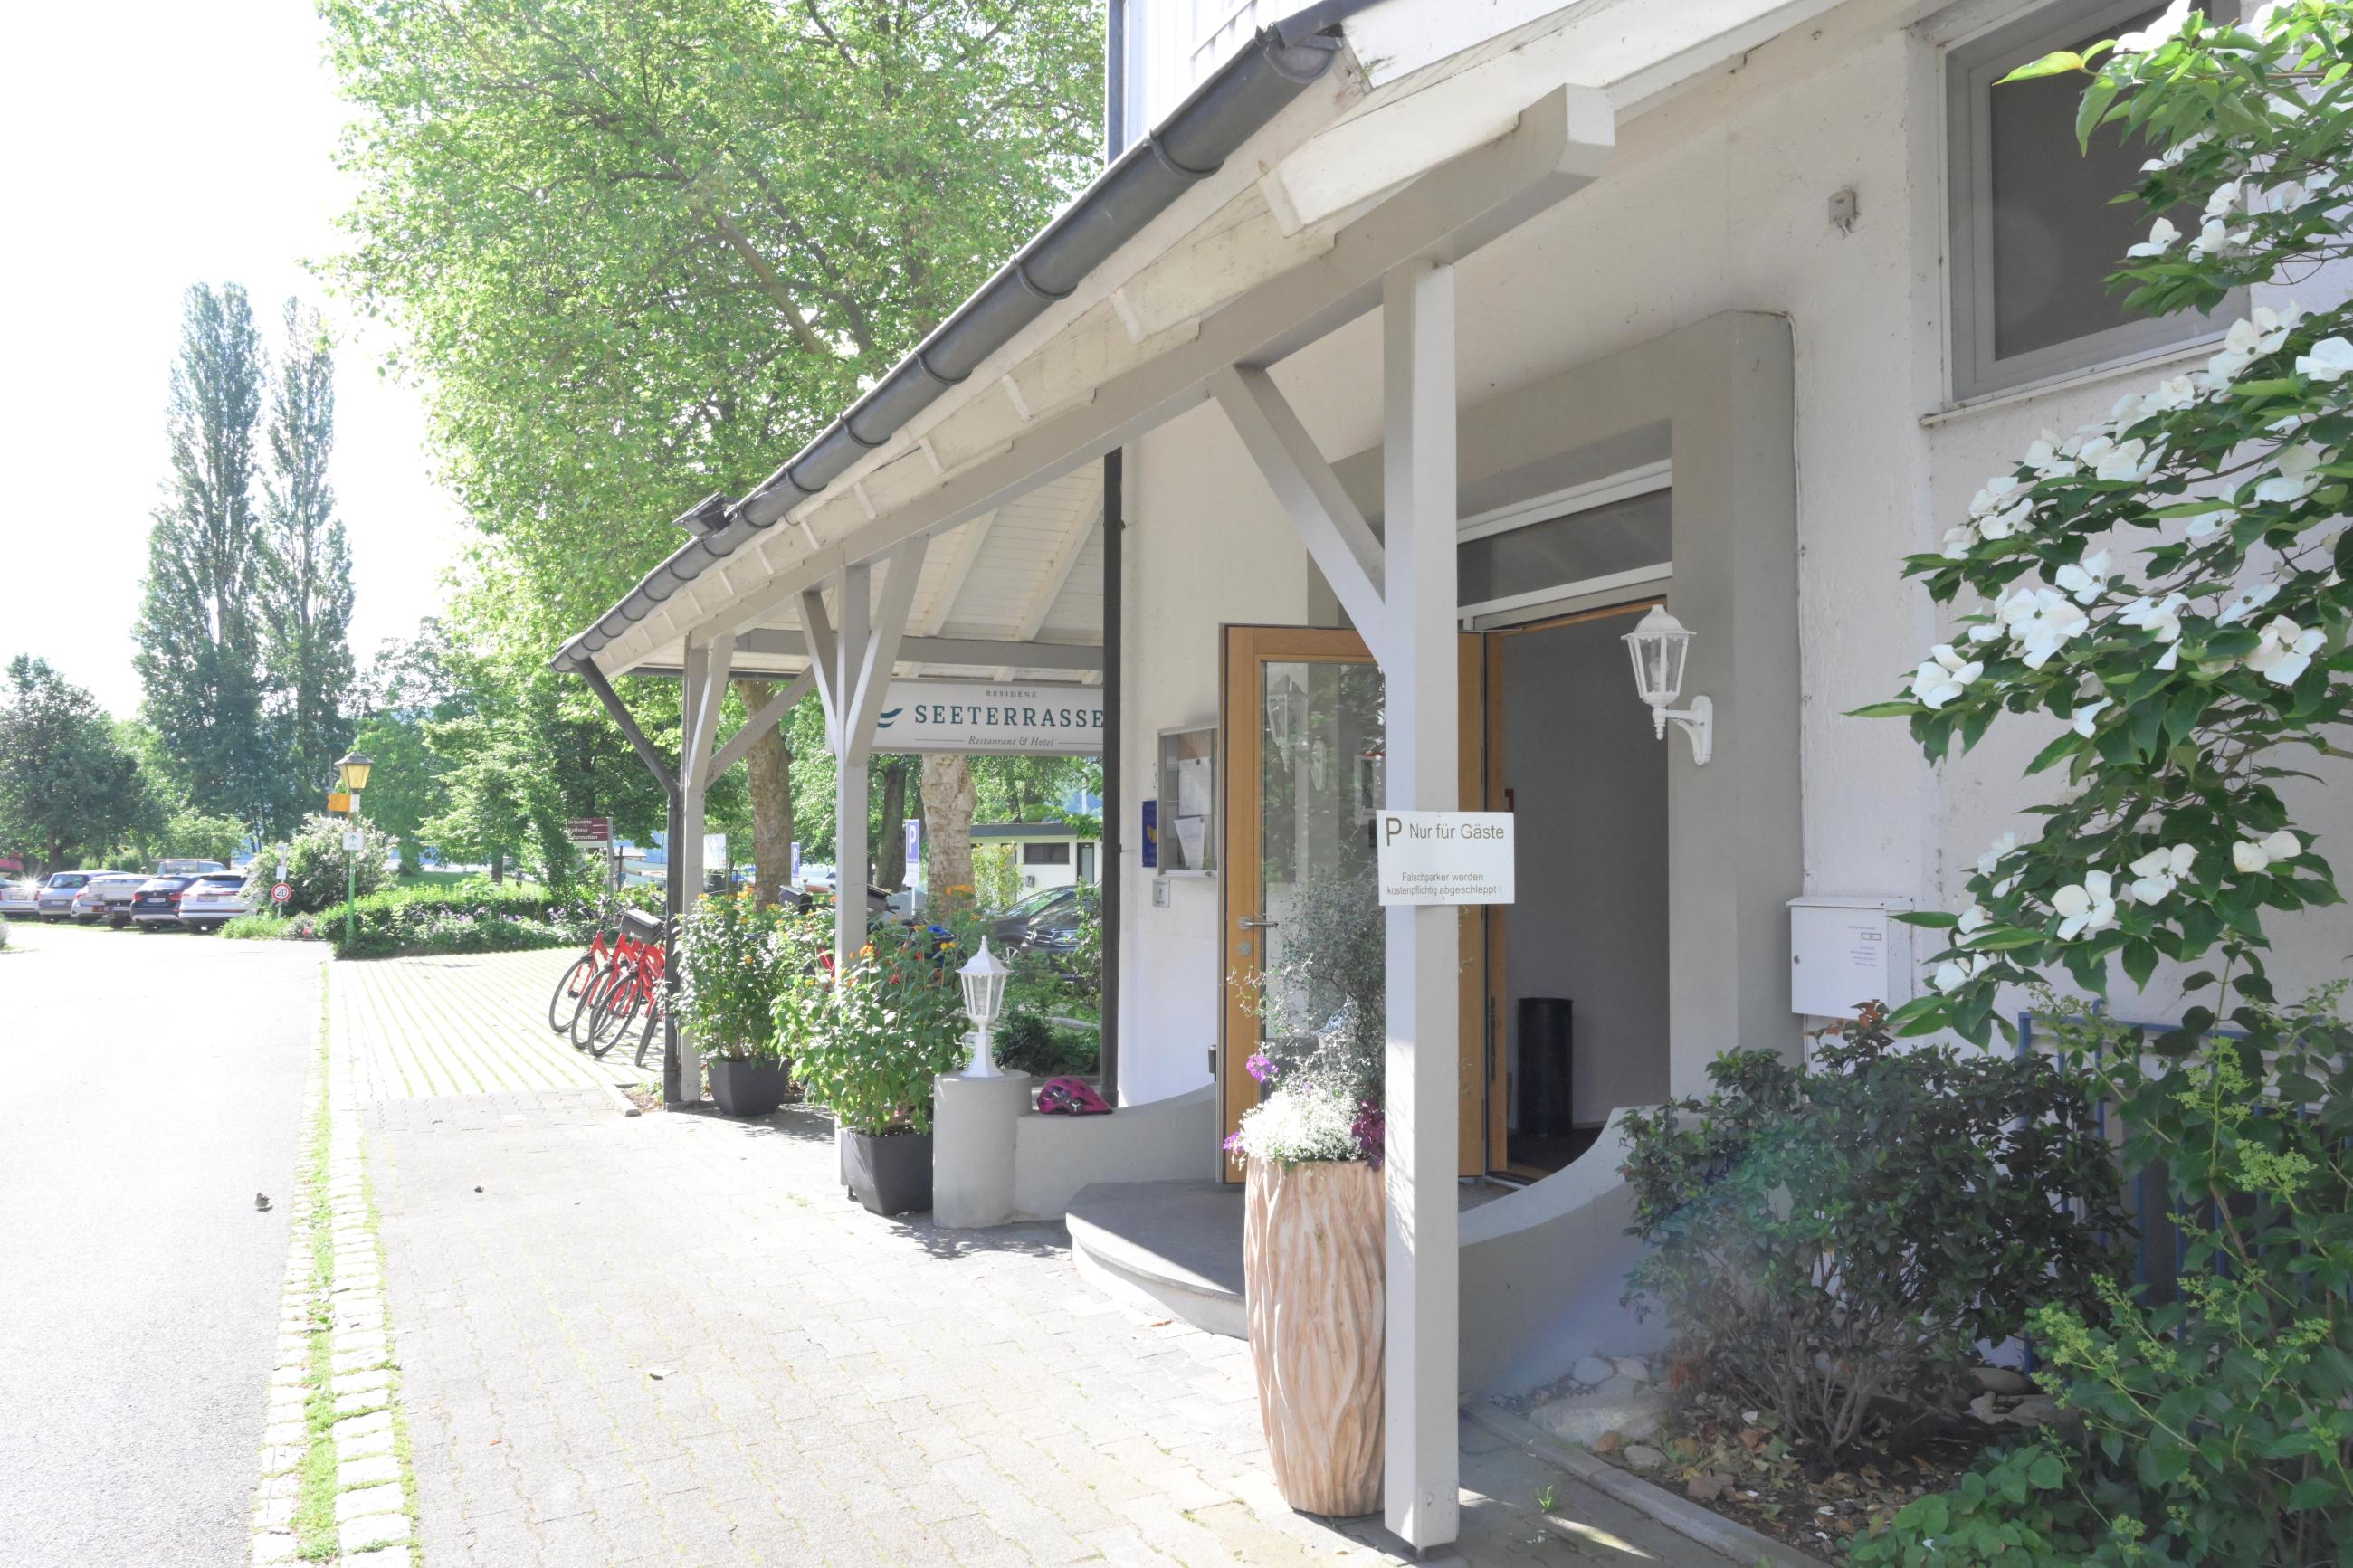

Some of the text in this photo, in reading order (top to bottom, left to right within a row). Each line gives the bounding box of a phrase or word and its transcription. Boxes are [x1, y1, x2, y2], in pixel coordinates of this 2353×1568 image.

[915, 704, 1103, 728] SEETERRASSE
[967, 735, 1054, 746] Restaurant & Hotel
[908, 825, 917, 854] P
[1386, 817, 1504, 847] P Nur für Gäste
[793, 847, 798, 870] P
[1402, 872, 1483, 883] Falschparker werden
[276, 888, 288, 898] 20
[1386, 885, 1437, 897] kostenpflichtig
[1439, 885, 1496, 897] abgeschleppt
